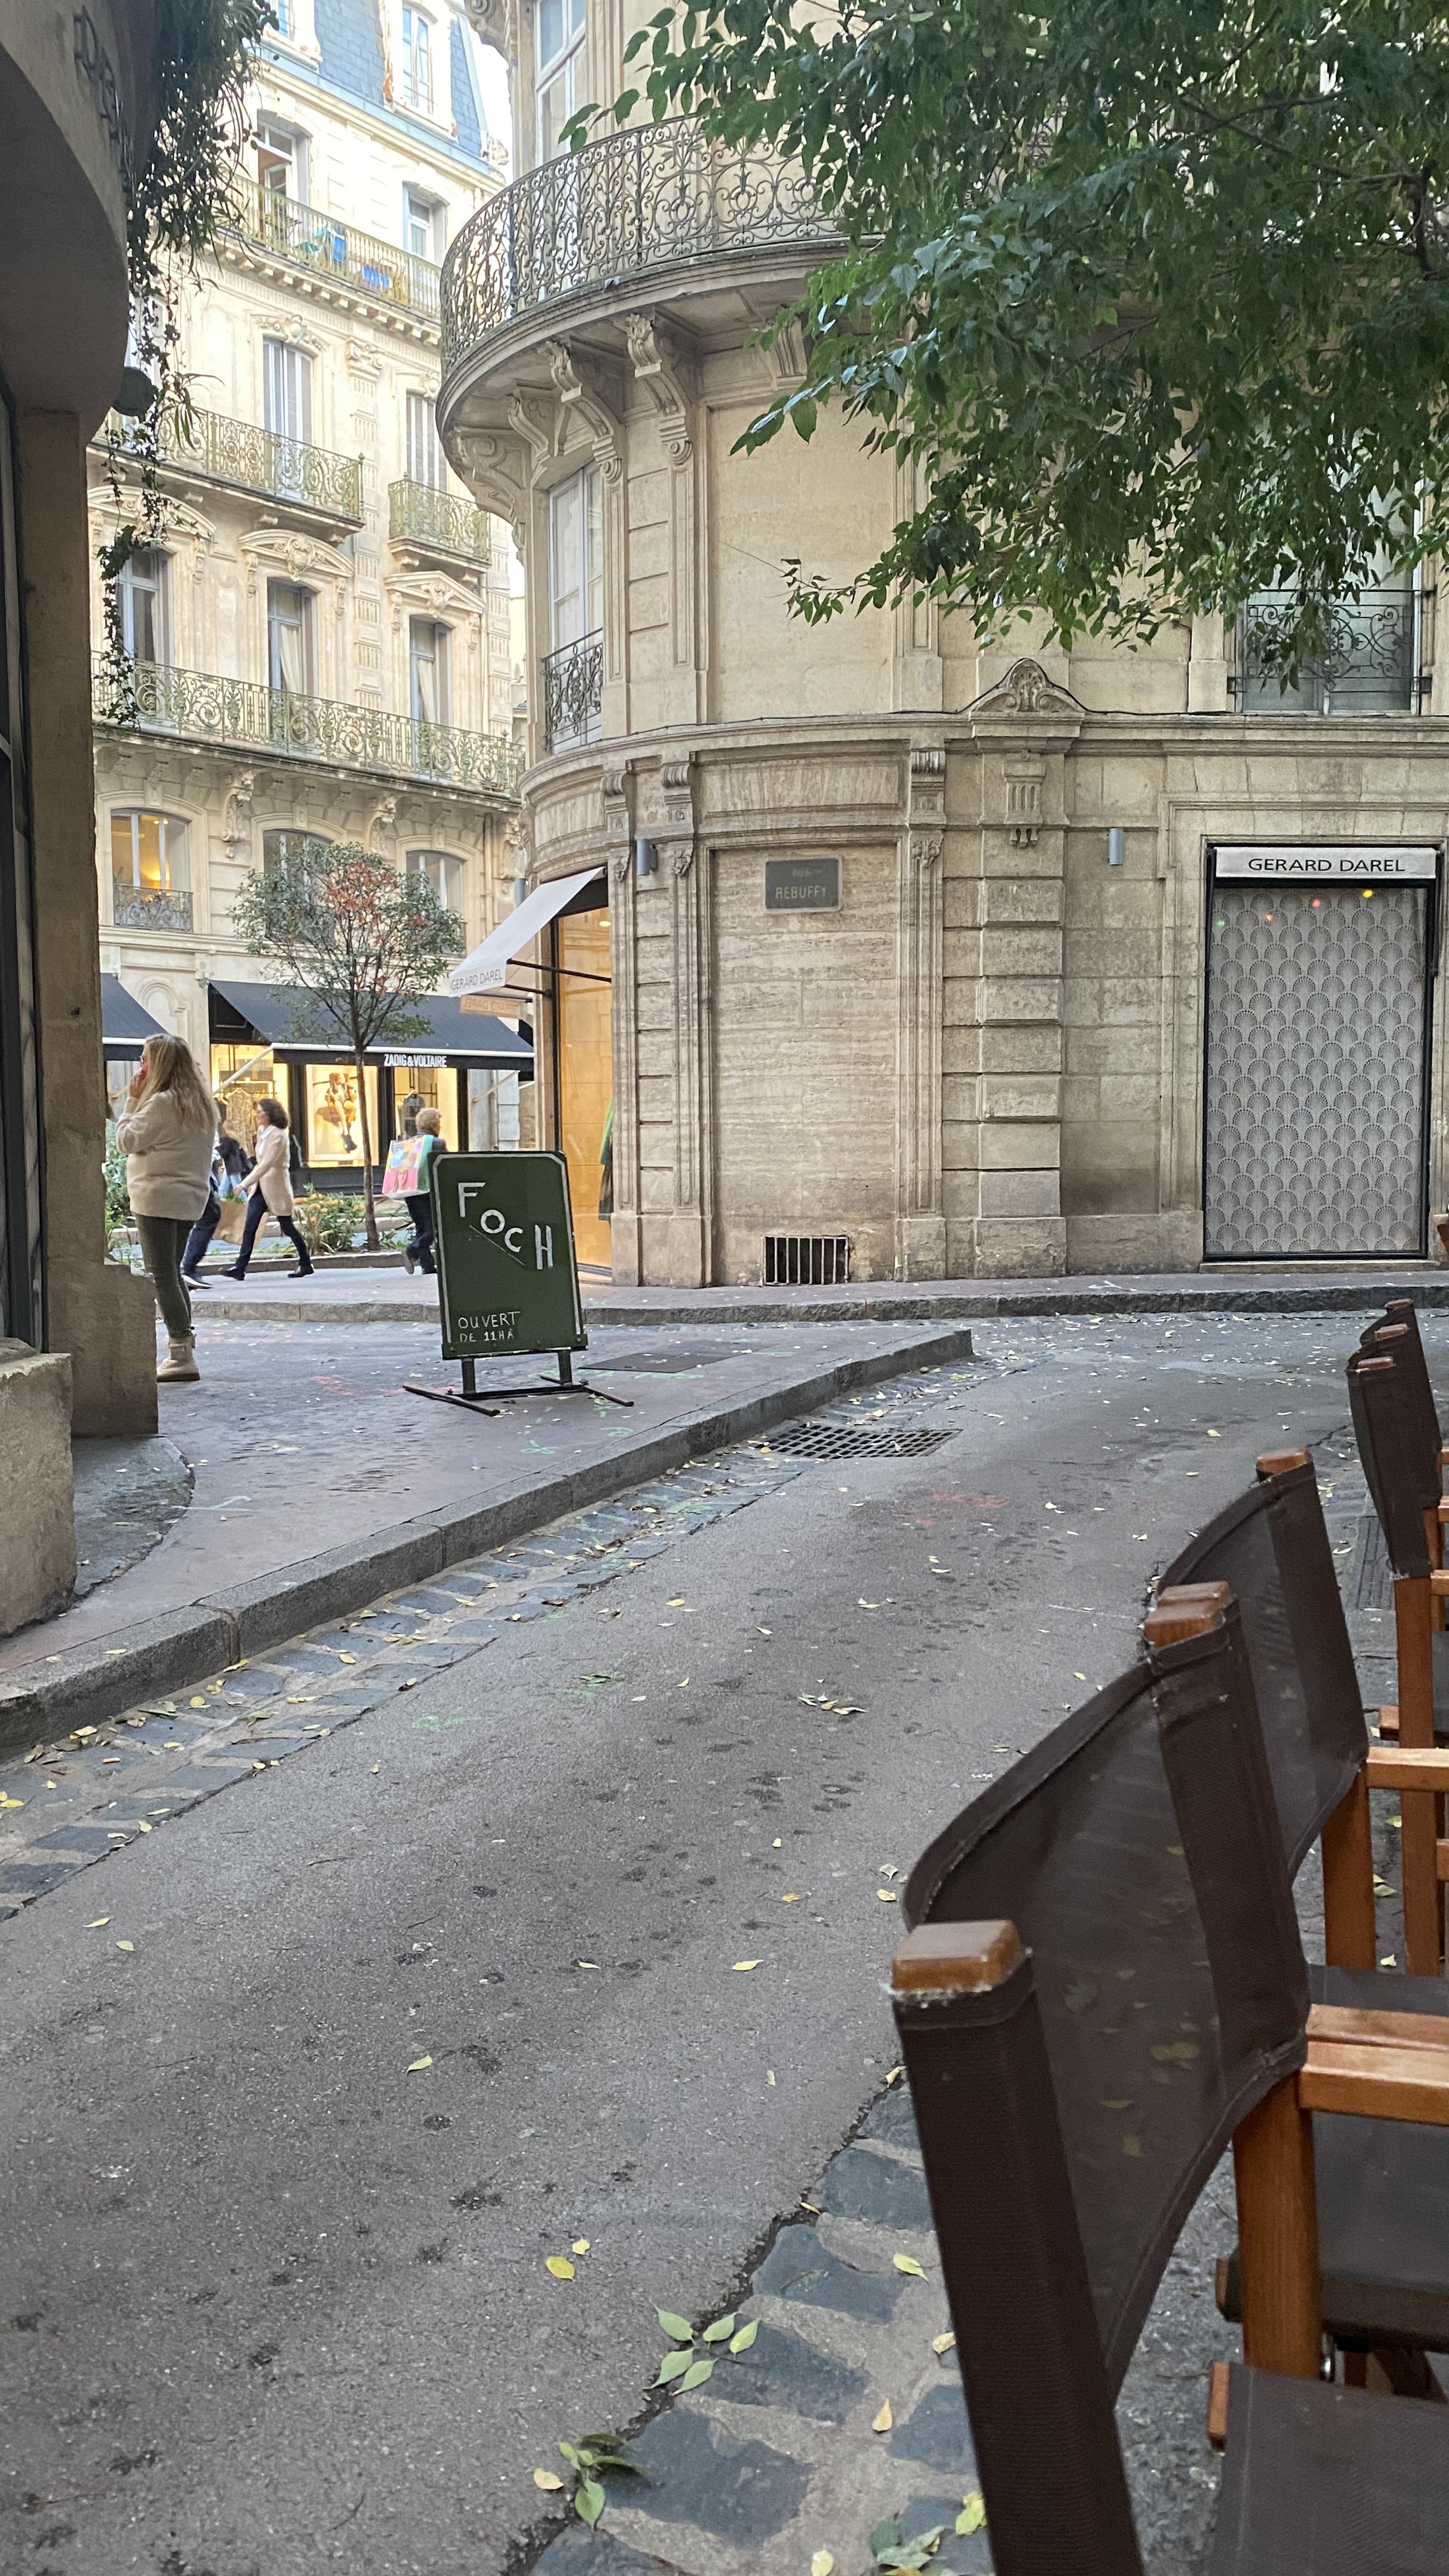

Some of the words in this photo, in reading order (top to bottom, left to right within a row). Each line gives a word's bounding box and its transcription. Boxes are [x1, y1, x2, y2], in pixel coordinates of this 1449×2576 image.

[1248, 859, 1332, 871] GERARD
[1340, 859, 1406, 872] DAREL
[776, 885, 827, 900] REBUFFY
[451, 975, 478, 990] GERARD
[480, 969, 503, 984] DAREL
[458, 1183, 553, 1269] FOCH
[458, 1311, 521, 1328] OUVERT
[459, 1333, 477, 1342] DE
